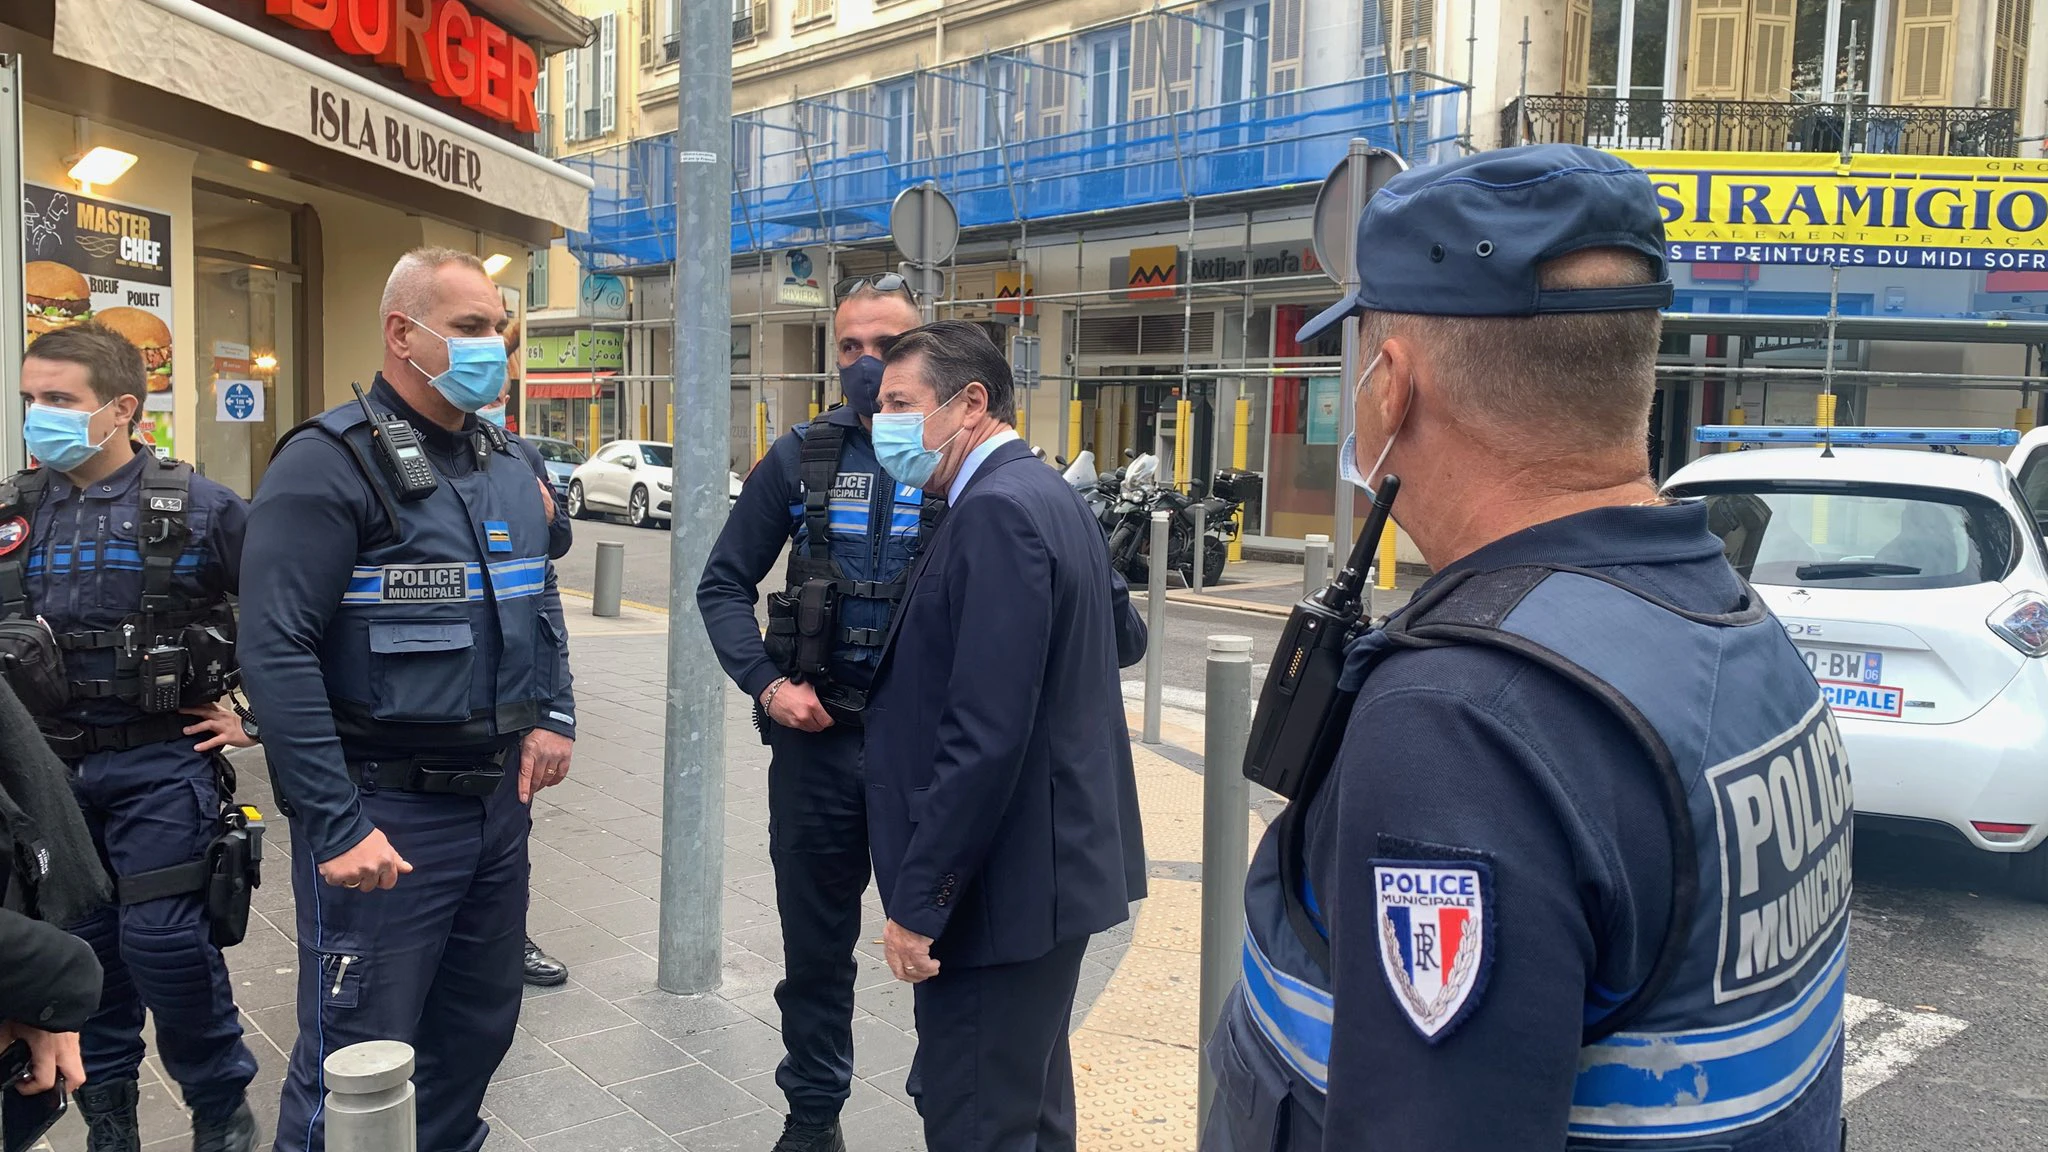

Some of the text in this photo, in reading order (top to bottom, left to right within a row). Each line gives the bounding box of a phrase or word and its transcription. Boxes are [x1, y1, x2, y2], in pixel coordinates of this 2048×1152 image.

[310, 86, 483, 193] ISLA BURGER
[77, 202, 150, 240] MASTER
[1895, 233, 1932, 243] DE
[120, 236, 161, 266] CHEF
[1695, 246, 1721, 261] ET
[1735, 247, 1864, 264] PEINTURES
[1878, 250, 1908, 265] DU
[1922, 251, 1971, 267] MIDI
[89, 277, 119, 294] BOEUF
[127, 290, 160, 307] POULET
[388, 569, 461, 586] POLICE
[388, 586, 461, 599] MUNICIPALE
[1864, 669, 1879, 681] 06
[1380, 872, 1475, 895] POLICE
[1381, 894, 1475, 907] MUNICIPALE
